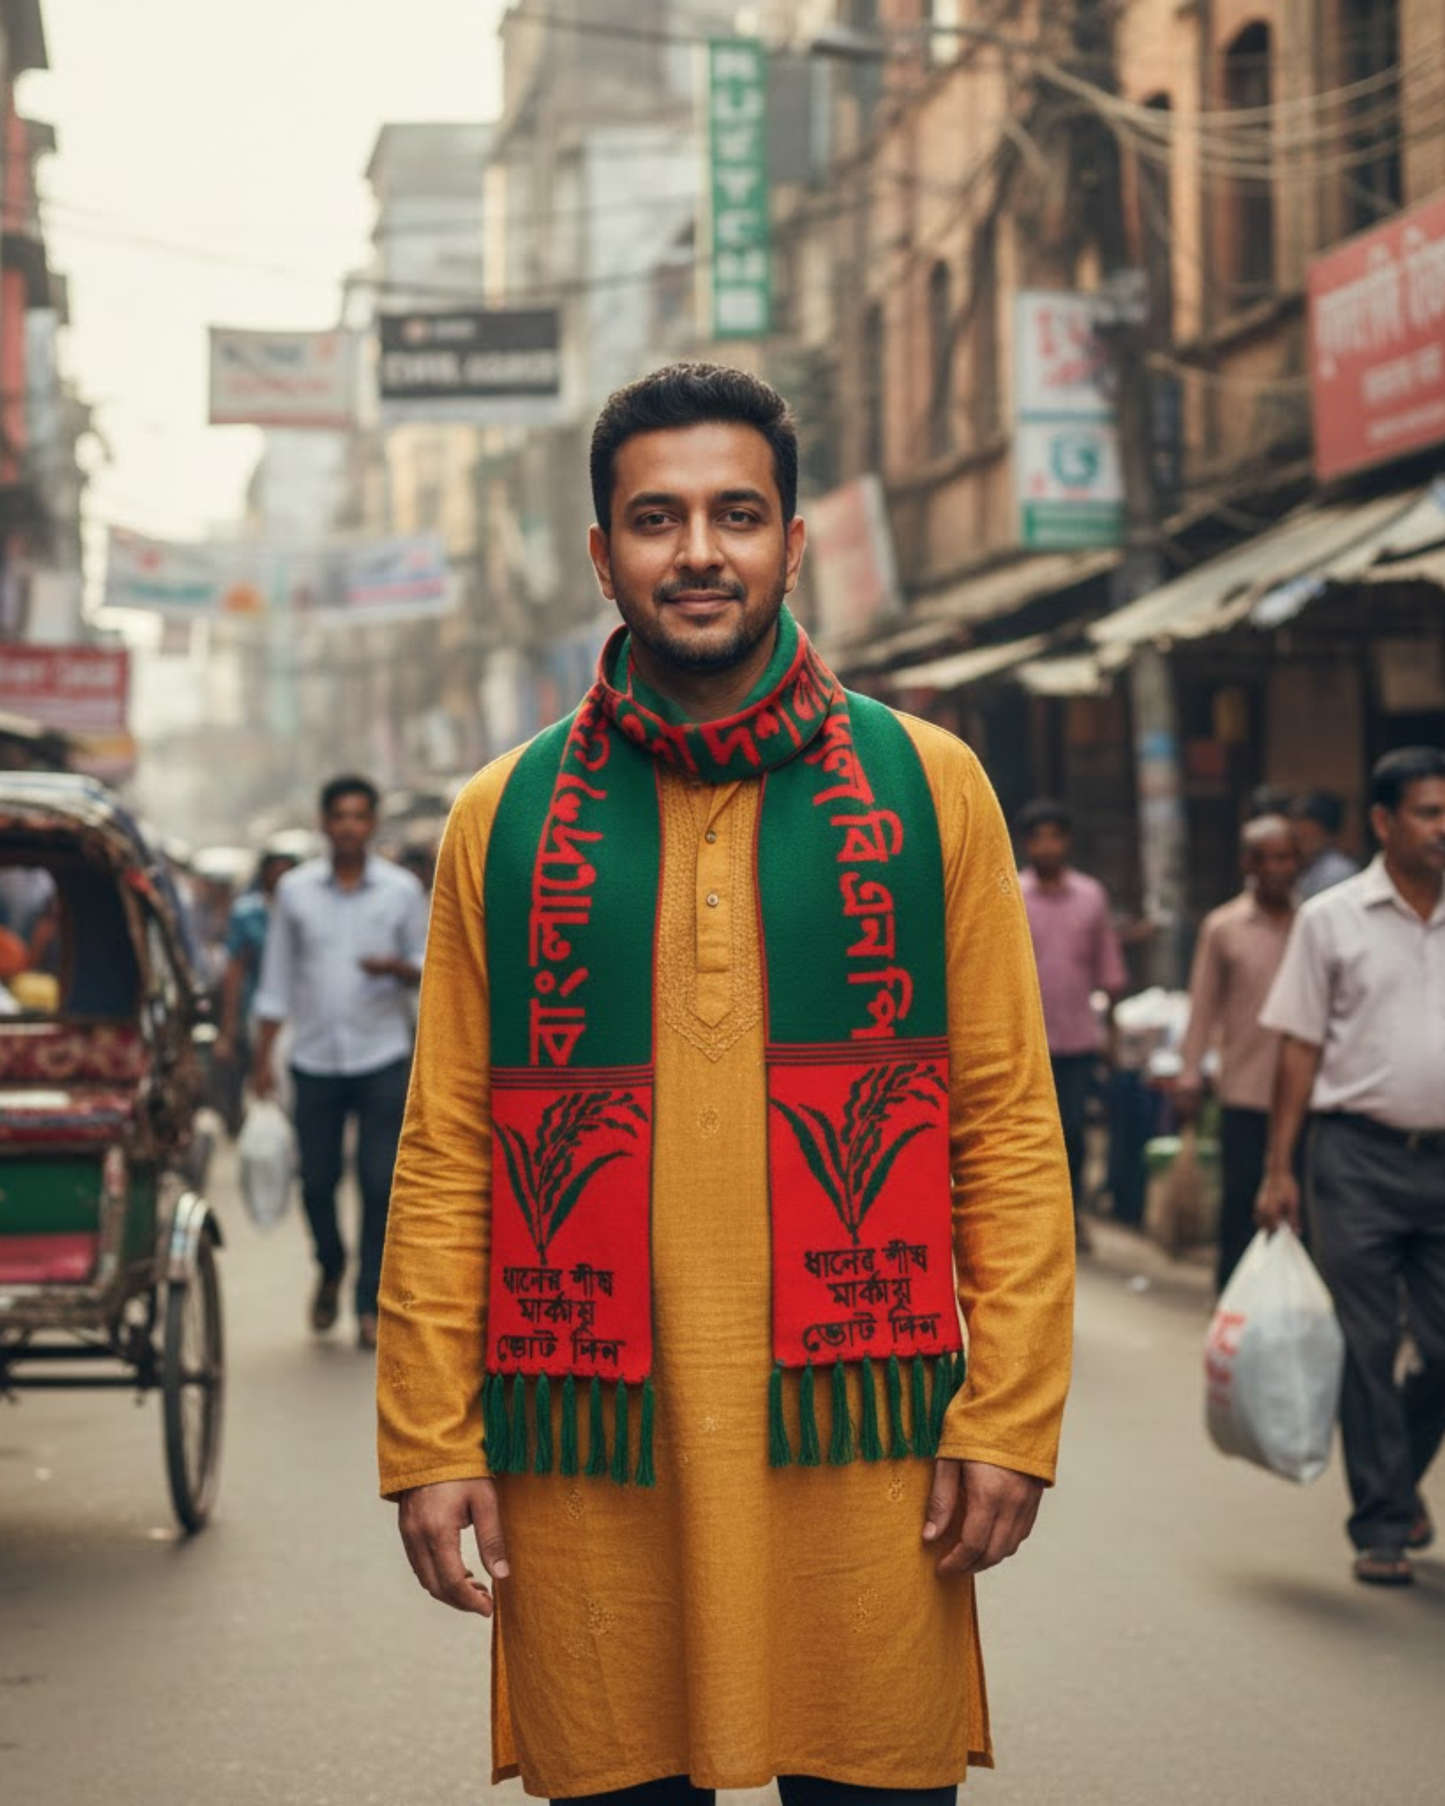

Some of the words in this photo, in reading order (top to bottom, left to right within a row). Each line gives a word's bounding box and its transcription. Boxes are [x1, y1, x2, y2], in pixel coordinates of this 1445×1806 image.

[528, 772, 608, 1067] বাংলাদেশ
[497, 1329, 558, 1362] ভোট
[570, 1331, 626, 1367] দিন
[802, 1312, 878, 1352] ভোট
[888, 1305, 941, 1343] দিন
